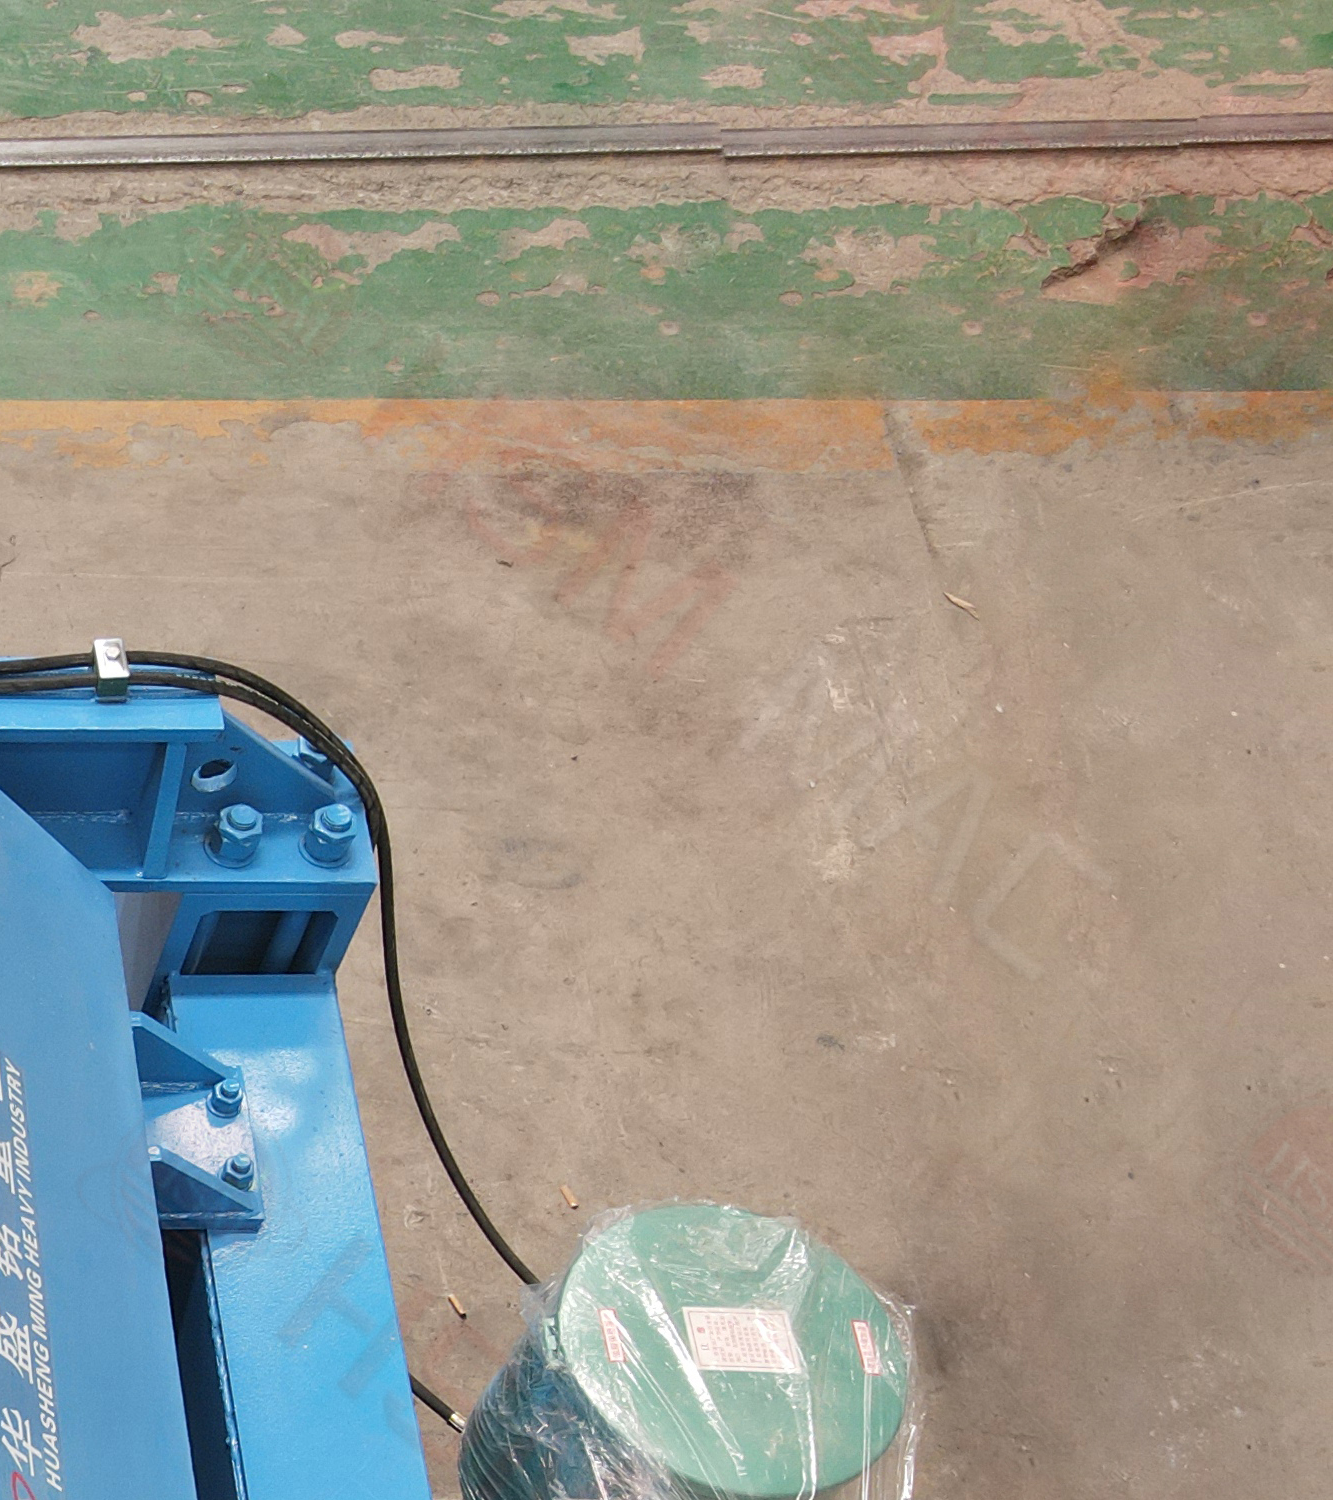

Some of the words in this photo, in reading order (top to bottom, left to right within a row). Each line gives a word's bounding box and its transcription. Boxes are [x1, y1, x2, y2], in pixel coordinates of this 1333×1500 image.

[5, 1057, 32, 1182] INDUSTRY
[17, 1179, 40, 1268] HEAVY
[26, 1267, 47, 1341] MING
[33, 1340, 63, 1492] HUASHENG
